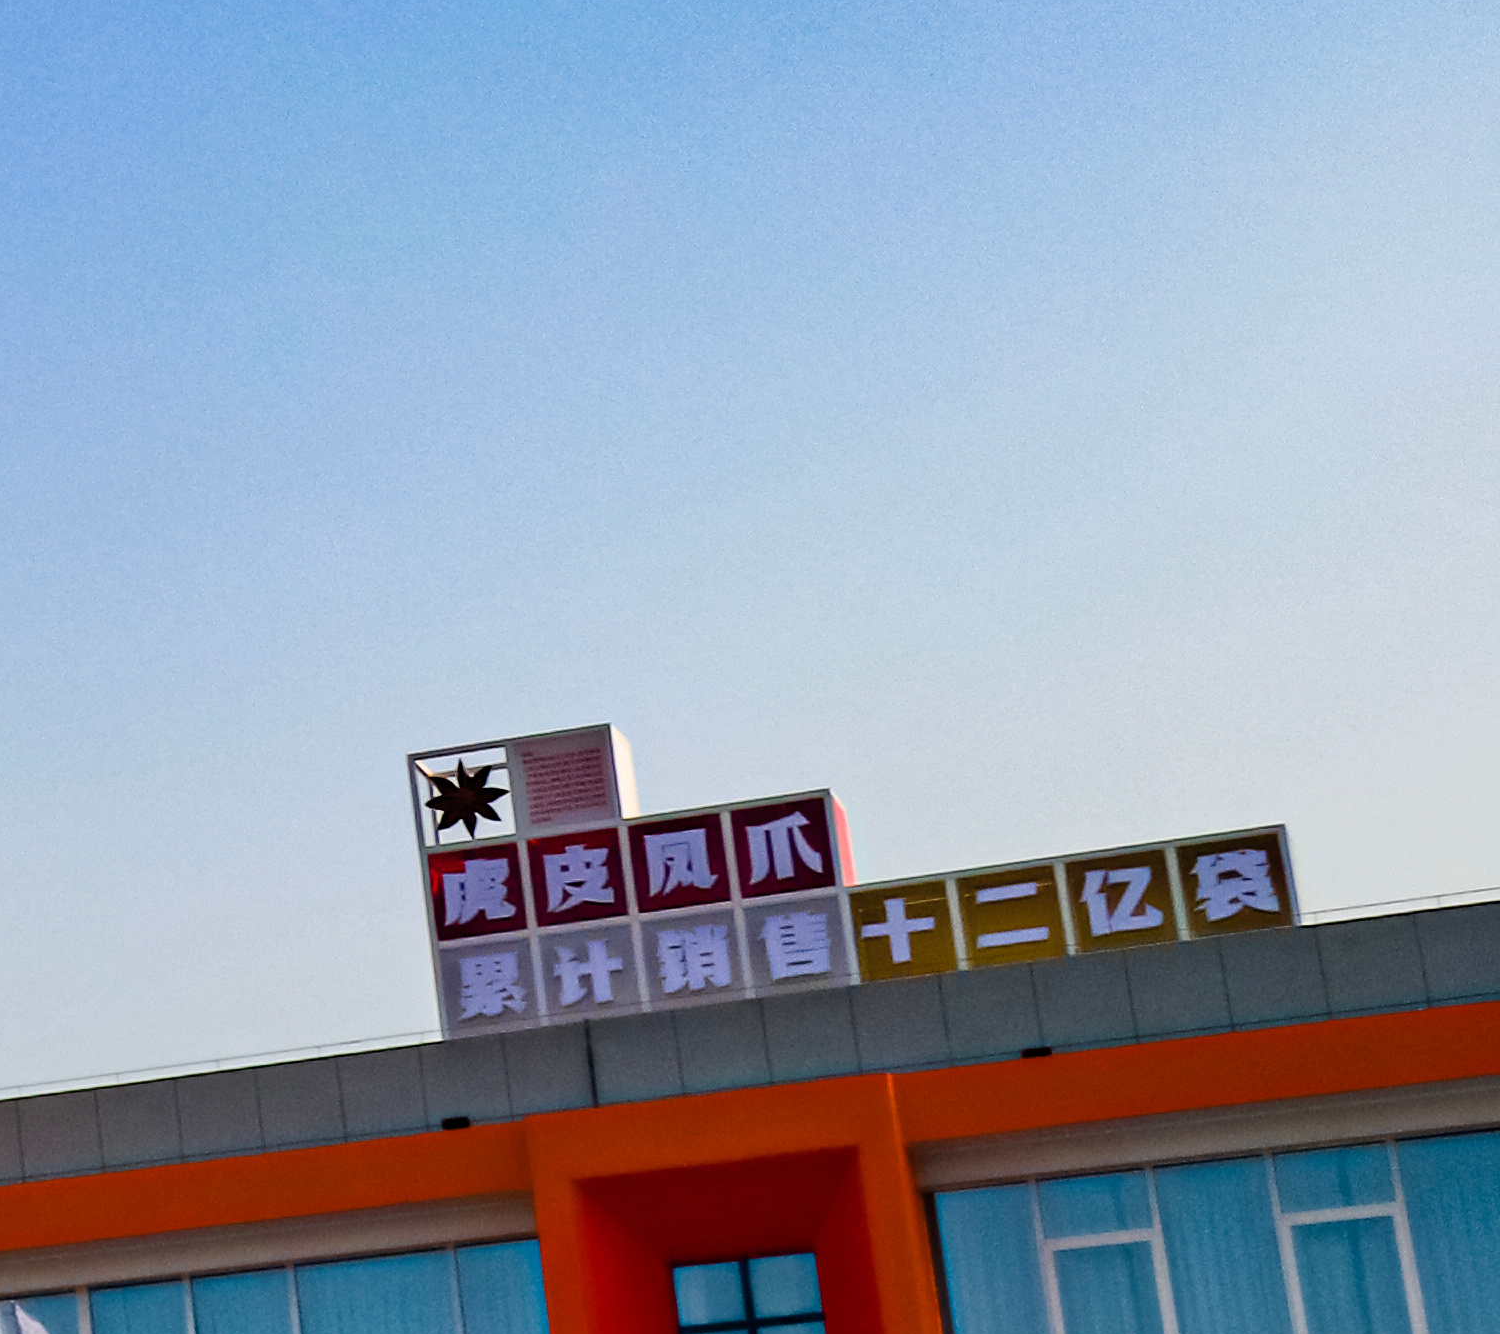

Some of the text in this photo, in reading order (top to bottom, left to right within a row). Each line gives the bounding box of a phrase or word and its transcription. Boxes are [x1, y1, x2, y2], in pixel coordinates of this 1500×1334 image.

[443, 810, 823, 928] 虎皮凤爪
[457, 848, 1283, 1022] 累计销售 十二亿袋
